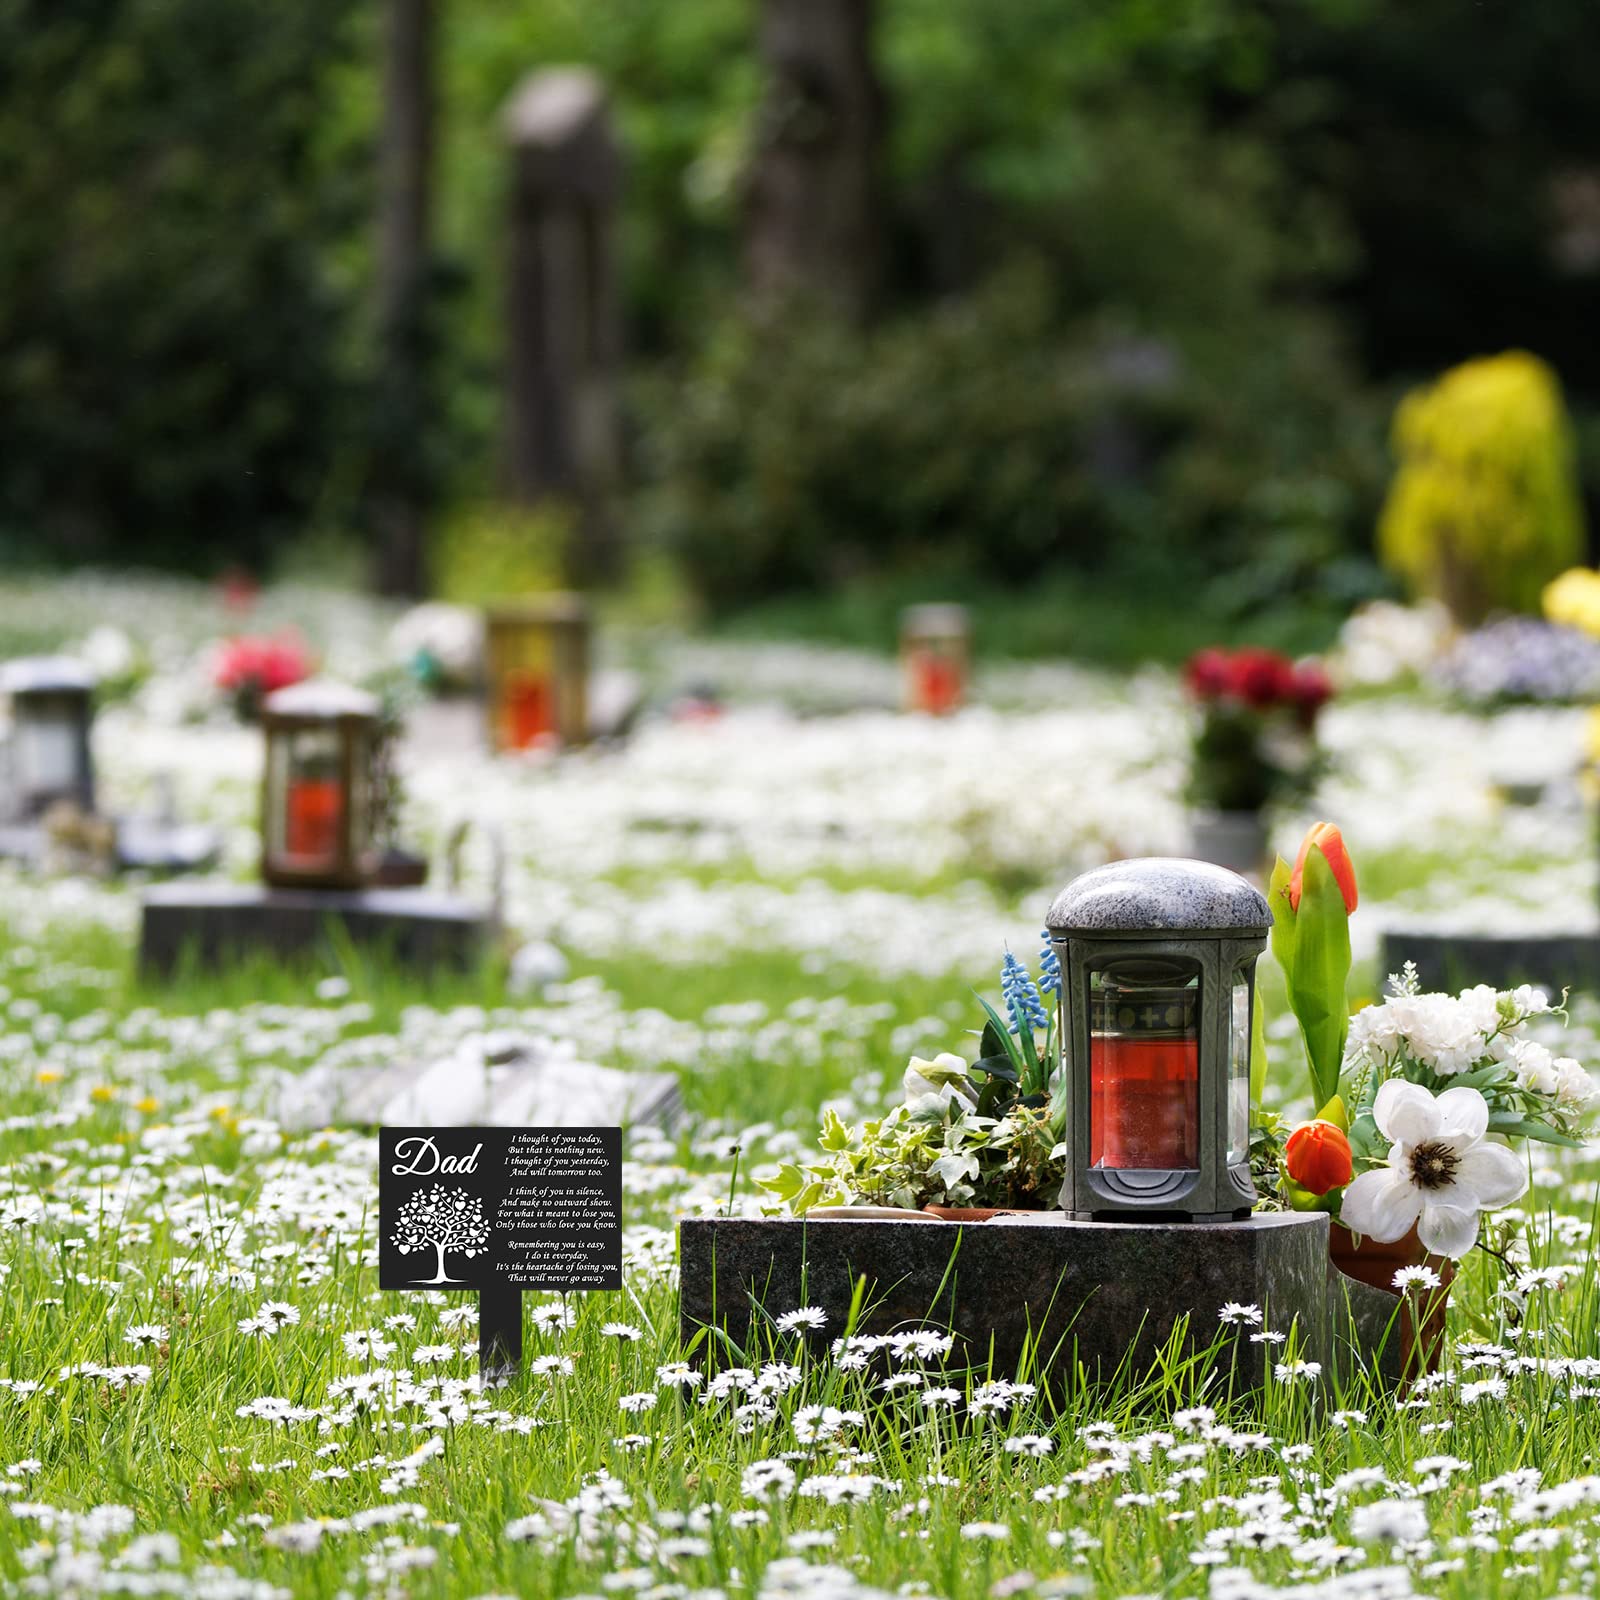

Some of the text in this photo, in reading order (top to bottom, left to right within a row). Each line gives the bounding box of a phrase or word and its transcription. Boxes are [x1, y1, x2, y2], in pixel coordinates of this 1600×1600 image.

[518, 1134, 548, 1145] thought
[551, 1134, 561, 1145] of
[561, 1136, 575, 1145] you
[578, 1134, 602, 1145] today,
[391, 1135, 483, 1176] Dad
[554, 1146, 584, 1155] nothing
[511, 1156, 541, 1167] thought
[544, 1156, 553, 1167] of
[554, 1158, 568, 1167] you
[570, 1156, 609, 1167] yesterday,
[510, 1168, 528, 1176] And
[530, 1168, 548, 1176] will
[516, 1187, 539, 1196] think
[539, 1187, 549, 1197] of
[576, 1187, 604, 1196] silence,
[499, 1198, 520, 1207] And
[520, 1198, 540, 1208] make
[554, 1198, 588, 1206] outward
[590, 1198, 612, 1206] show.
[514, 1209, 534, 1217] what
[582, 1209, 597, 1217] lose
[496, 1220, 515, 1230] Only
[559, 1220, 574, 1228] love
[576, 1222, 591, 1230] you
[593, 1220, 617, 1230] know.
[508, 1240, 559, 1250] Remembering
[532, 1251, 541, 1259] do
[552, 1251, 588, 1261] everyday.
[512, 1262, 524, 1270] the
[526, 1262, 564, 1270] heartache
[566, 1262, 576, 1272] of
[576, 1262, 600, 1272] losing
[570, 1275, 580, 1284] go
